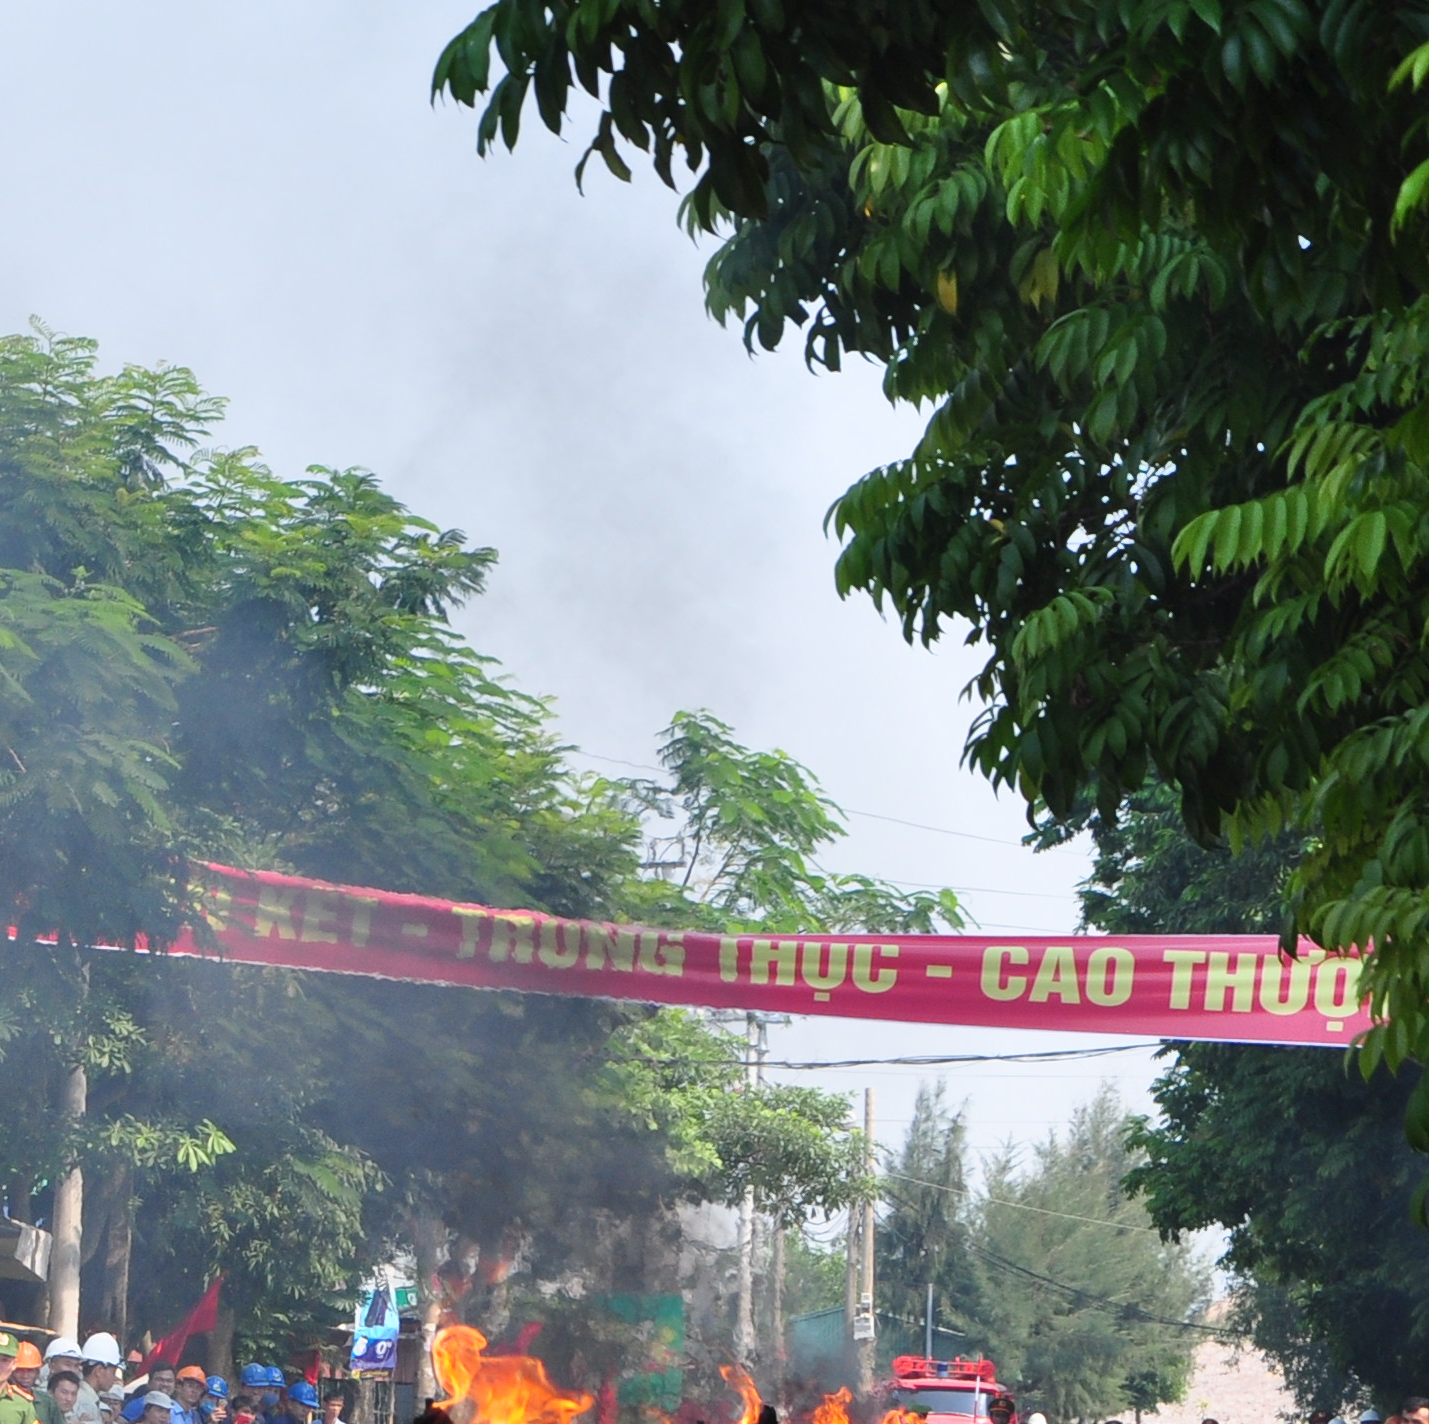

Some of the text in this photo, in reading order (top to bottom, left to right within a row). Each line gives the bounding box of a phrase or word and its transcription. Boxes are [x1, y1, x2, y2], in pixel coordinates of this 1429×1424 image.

[452, 905, 687, 977] TRUNG
[979, 945, 1136, 1007] CAO
[1163, 949, 1389, 1032] THƯỢ
